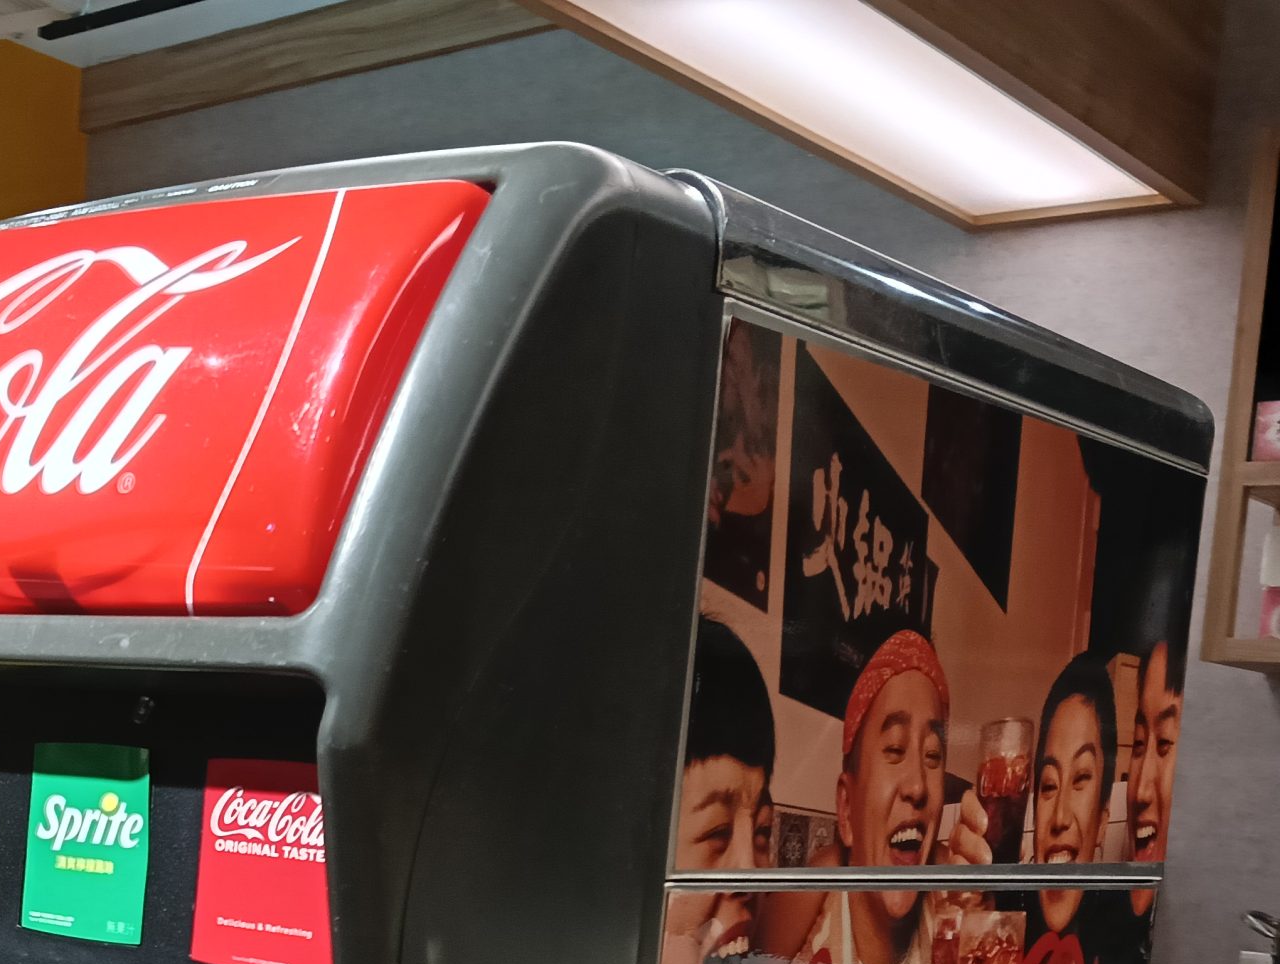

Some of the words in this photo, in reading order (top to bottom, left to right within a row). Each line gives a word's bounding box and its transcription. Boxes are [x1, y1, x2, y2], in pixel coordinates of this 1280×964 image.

[35, 792, 144, 851] Sprite
[214, 838, 279, 858] ORIGINAL
[281, 846, 326, 863] TASTE
[216, 916, 256, 931] Delicious
[257, 922, 263, 931] &
[265, 923, 313, 940] Refreshing
